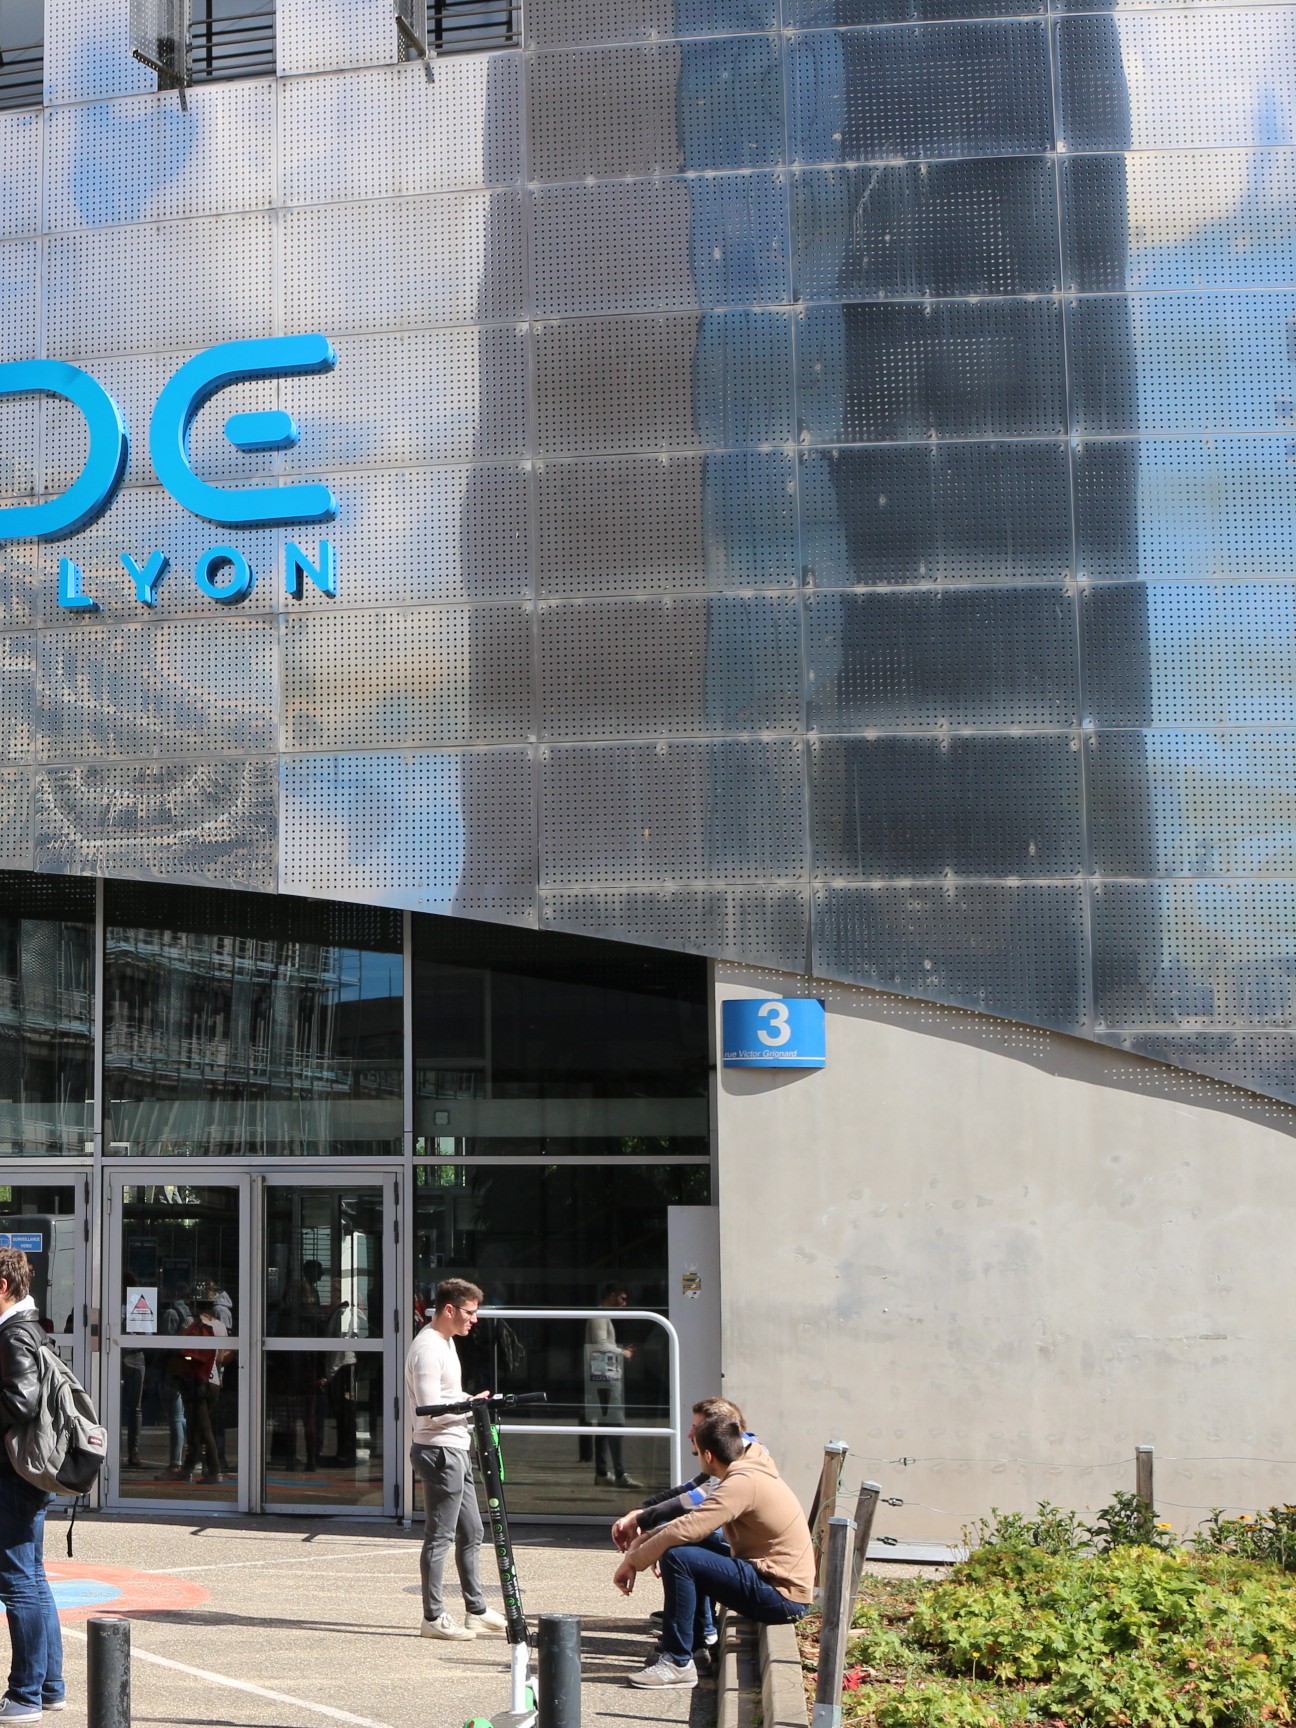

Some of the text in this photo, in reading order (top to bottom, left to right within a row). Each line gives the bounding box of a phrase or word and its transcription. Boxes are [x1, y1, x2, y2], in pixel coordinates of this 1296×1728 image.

[58, 539, 336, 610] LYON
[756, 1001, 791, 1047] 3
[738, 1050, 761, 1058] Victor
[762, 1049, 798, 1059] Grignard
